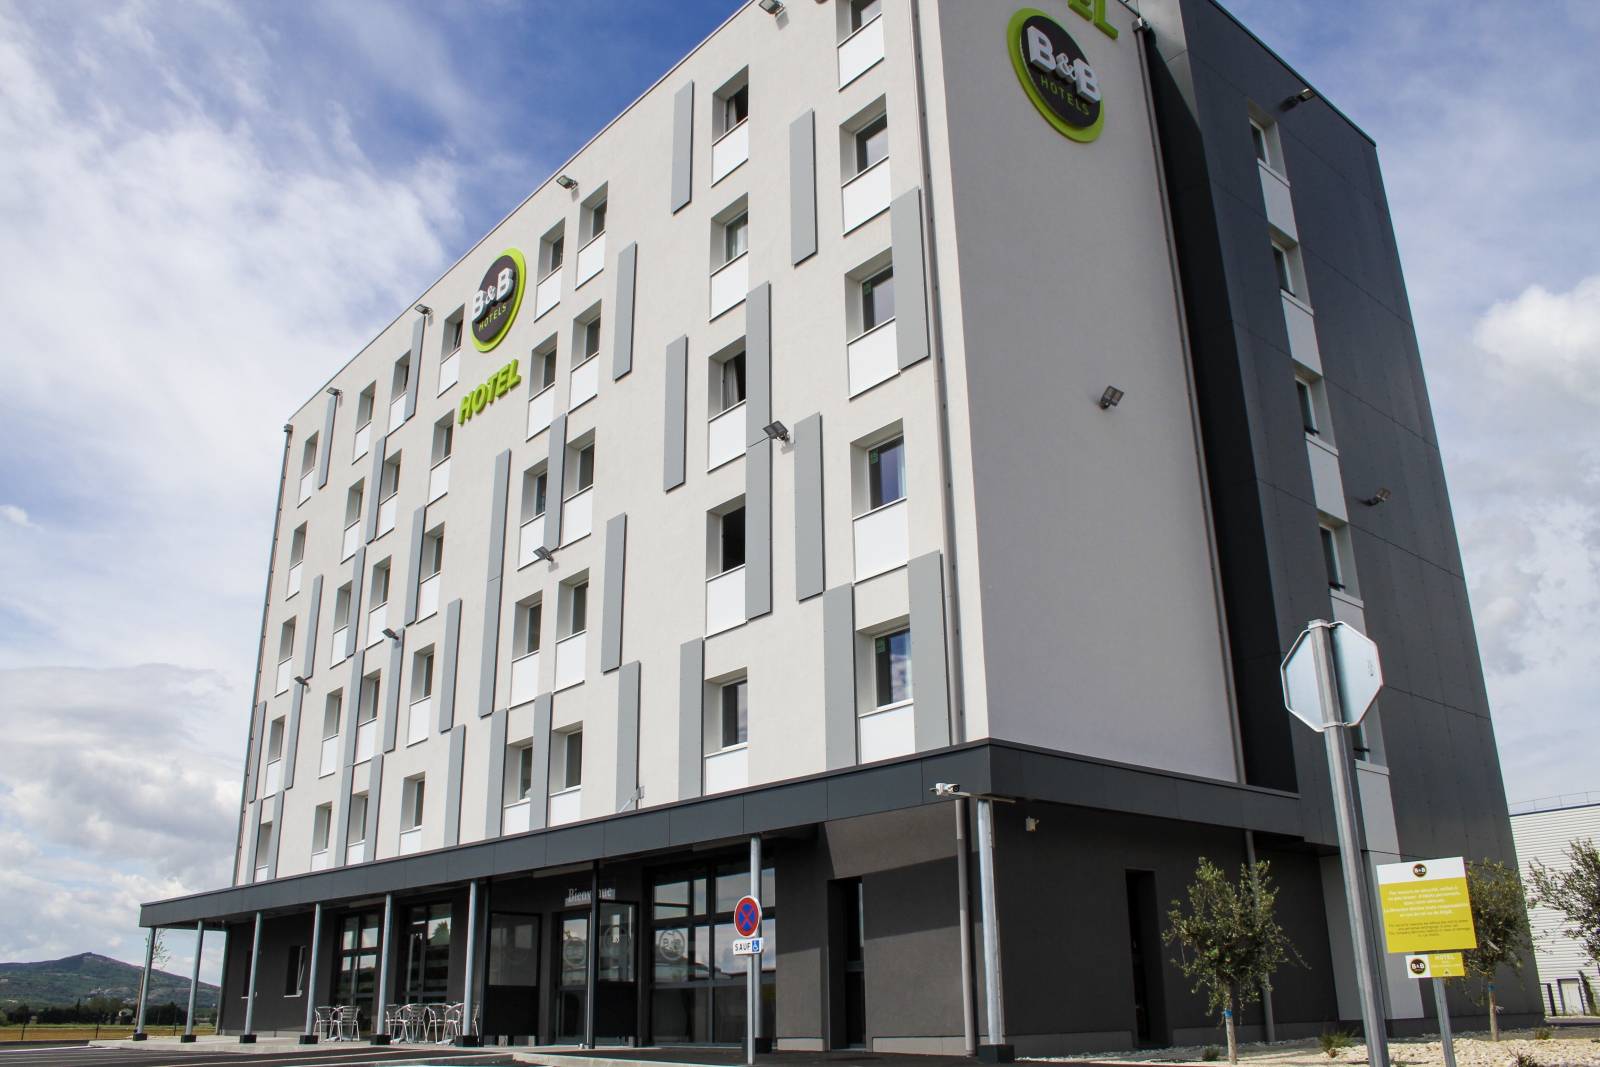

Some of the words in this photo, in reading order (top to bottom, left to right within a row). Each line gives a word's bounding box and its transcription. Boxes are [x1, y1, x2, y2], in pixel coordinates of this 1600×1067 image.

[1027, 26, 1101, 103] B&B
[1040, 74, 1089, 116] HOTELS
[472, 267, 513, 321] B&B
[478, 303, 507, 332] HOTELS
[458, 359, 521, 425] HOTEL
[735, 942, 751, 951] SAUF
